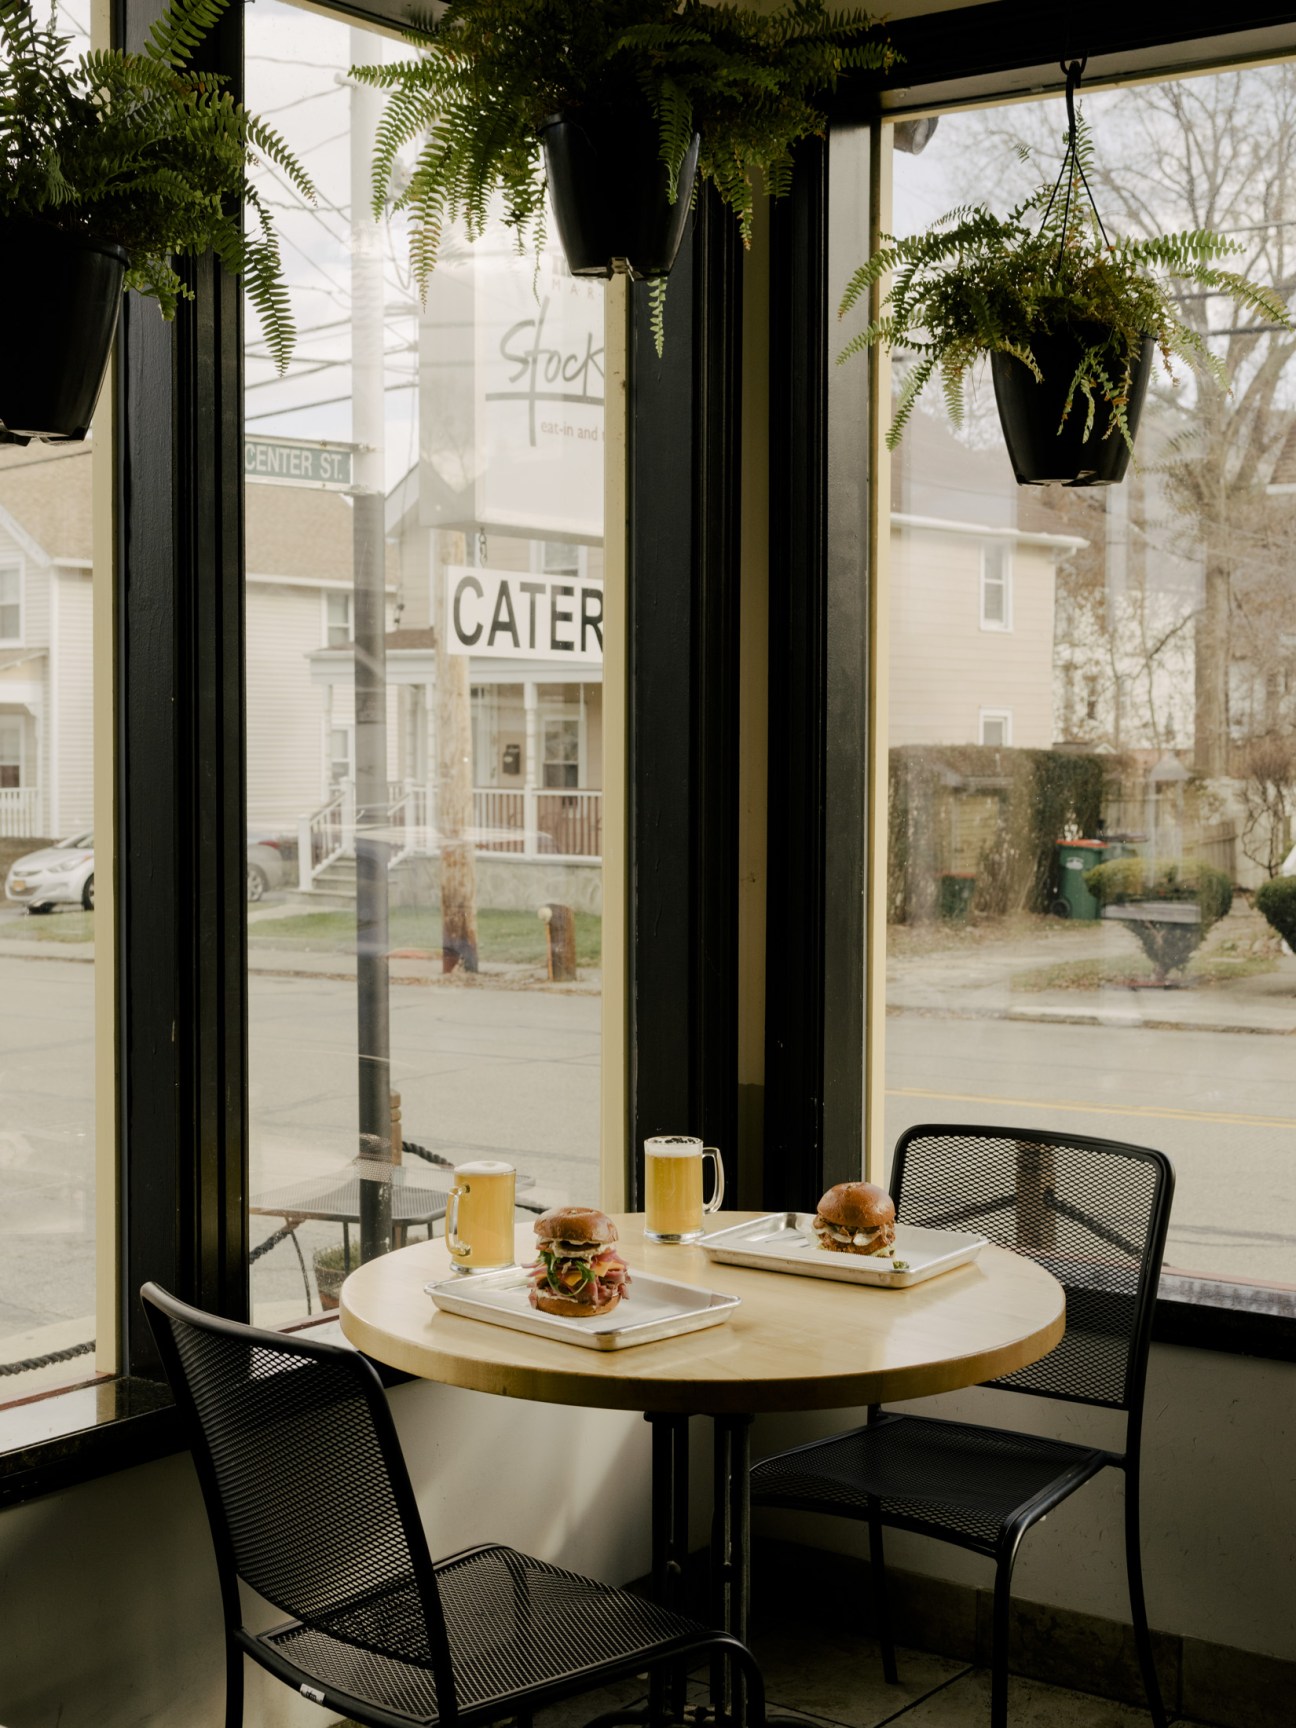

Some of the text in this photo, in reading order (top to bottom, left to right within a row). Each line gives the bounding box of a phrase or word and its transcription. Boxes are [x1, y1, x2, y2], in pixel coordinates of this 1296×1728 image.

[499, 295, 604, 447] Stock
[541, 421, 574, 437] eat-in
[577, 425, 598, 441] and
[245, 443, 343, 479] CENTER ST.
[453, 576, 603, 653] CATER
